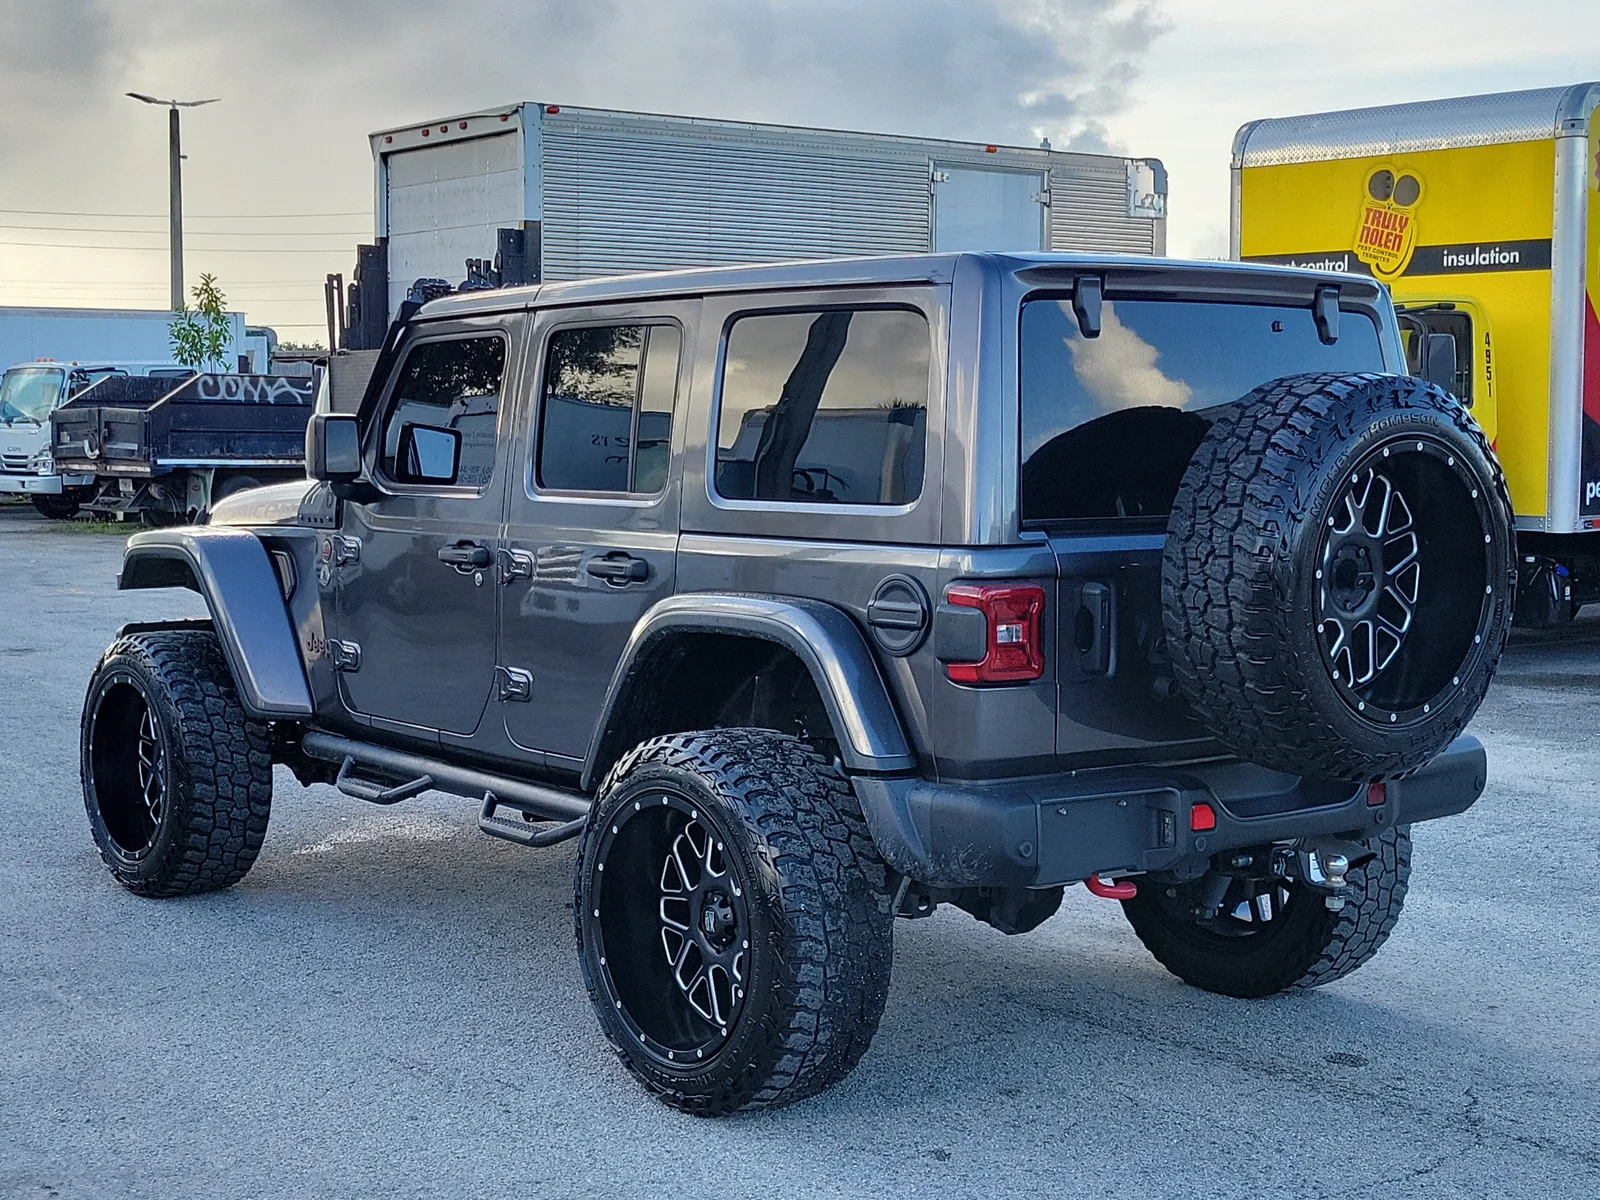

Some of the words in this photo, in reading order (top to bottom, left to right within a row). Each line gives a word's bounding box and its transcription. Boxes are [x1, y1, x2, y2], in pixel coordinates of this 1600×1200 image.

[1364, 207, 1409, 234] TRULY
[1356, 244, 1371, 252] PEST
[1372, 247, 1399, 259] CONTROL
[1359, 225, 1403, 252] NOLEN
[1362, 251, 1390, 263] TERMITES
[1443, 246, 1520, 267] insulation
[1360, 411, 1439, 441] THOMPSON
[306, 632, 330, 658] Jeep
